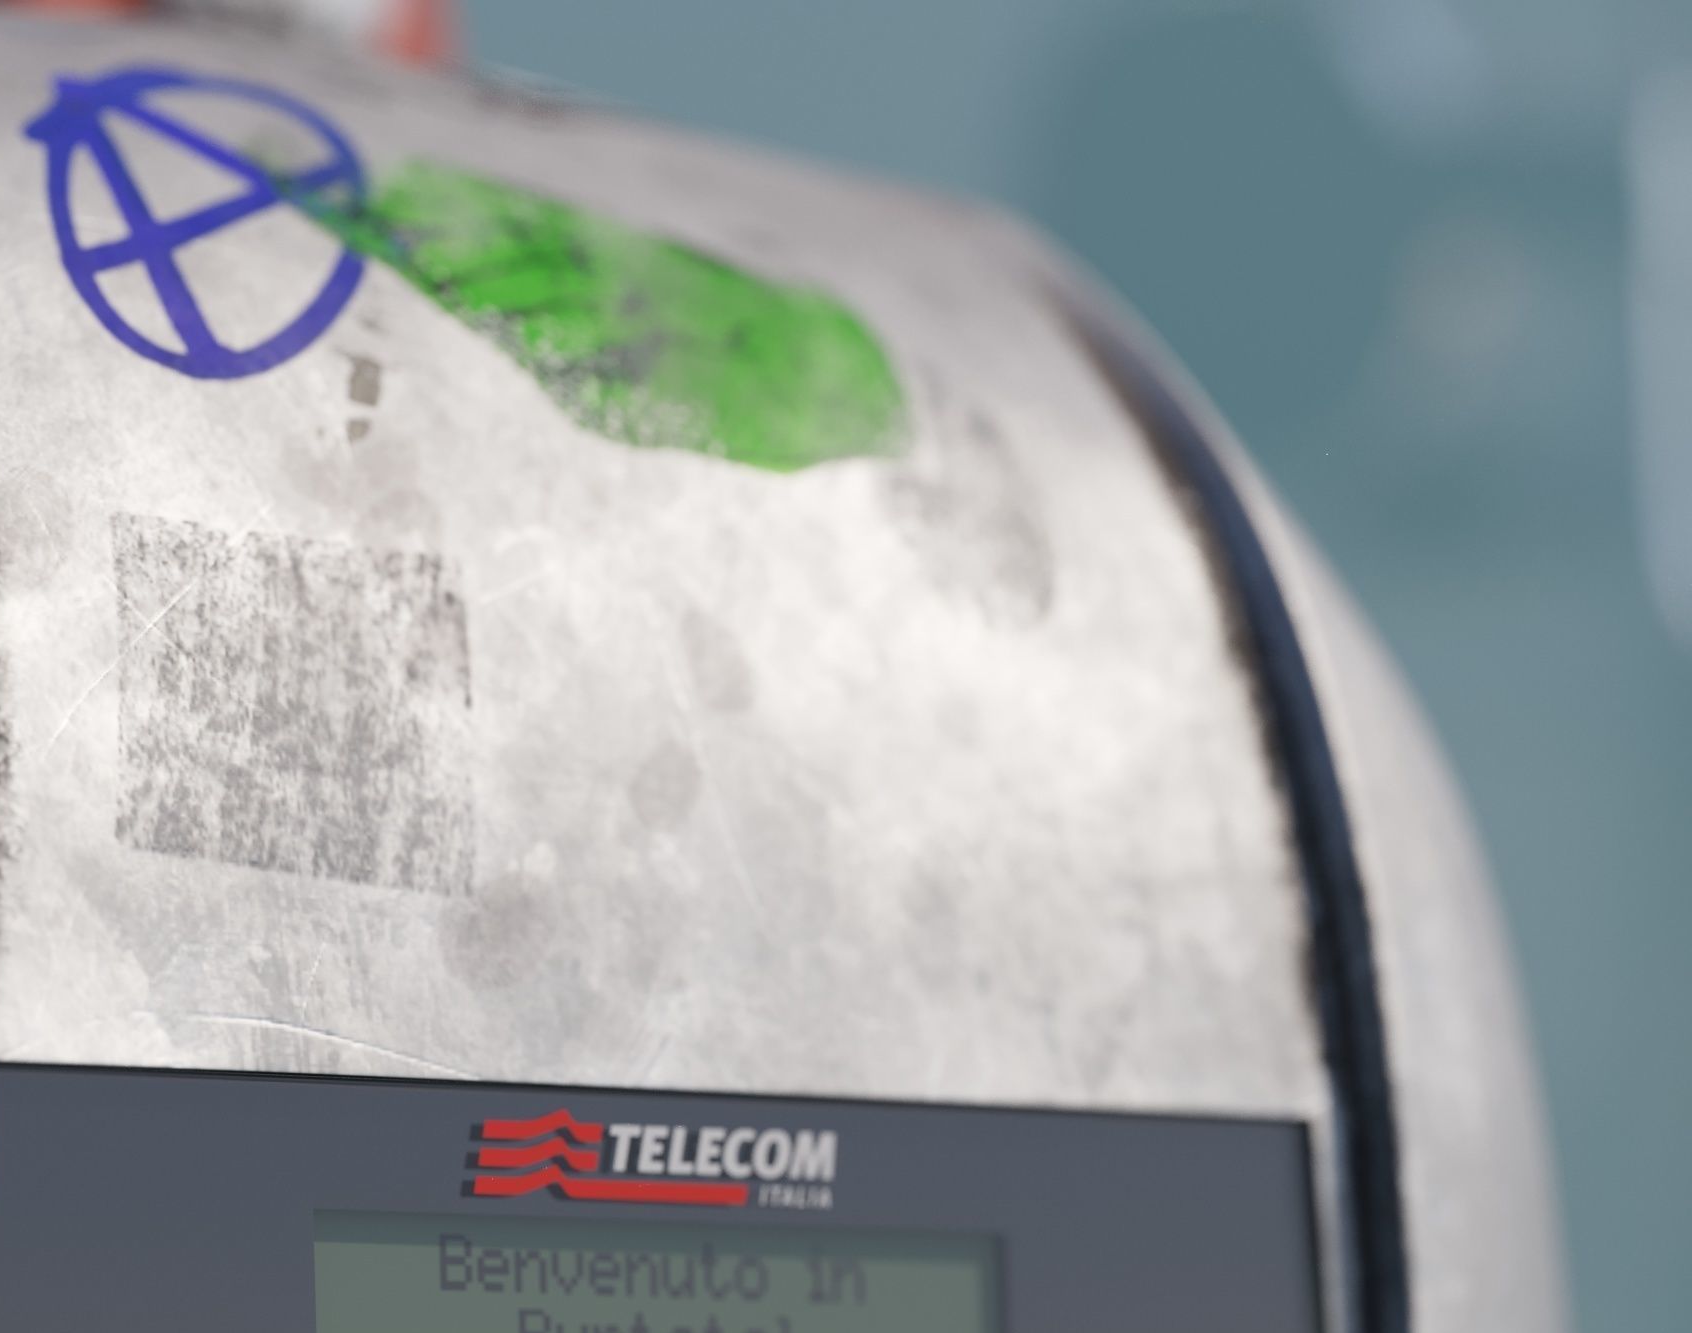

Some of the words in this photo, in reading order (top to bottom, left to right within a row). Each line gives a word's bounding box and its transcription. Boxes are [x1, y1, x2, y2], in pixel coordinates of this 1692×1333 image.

[609, 1122, 838, 1182] TELECOM
[758, 1184, 834, 1210] ITALIA
[439, 1233, 770, 1300] Benvenuto
[806, 1246, 870, 1308] in
